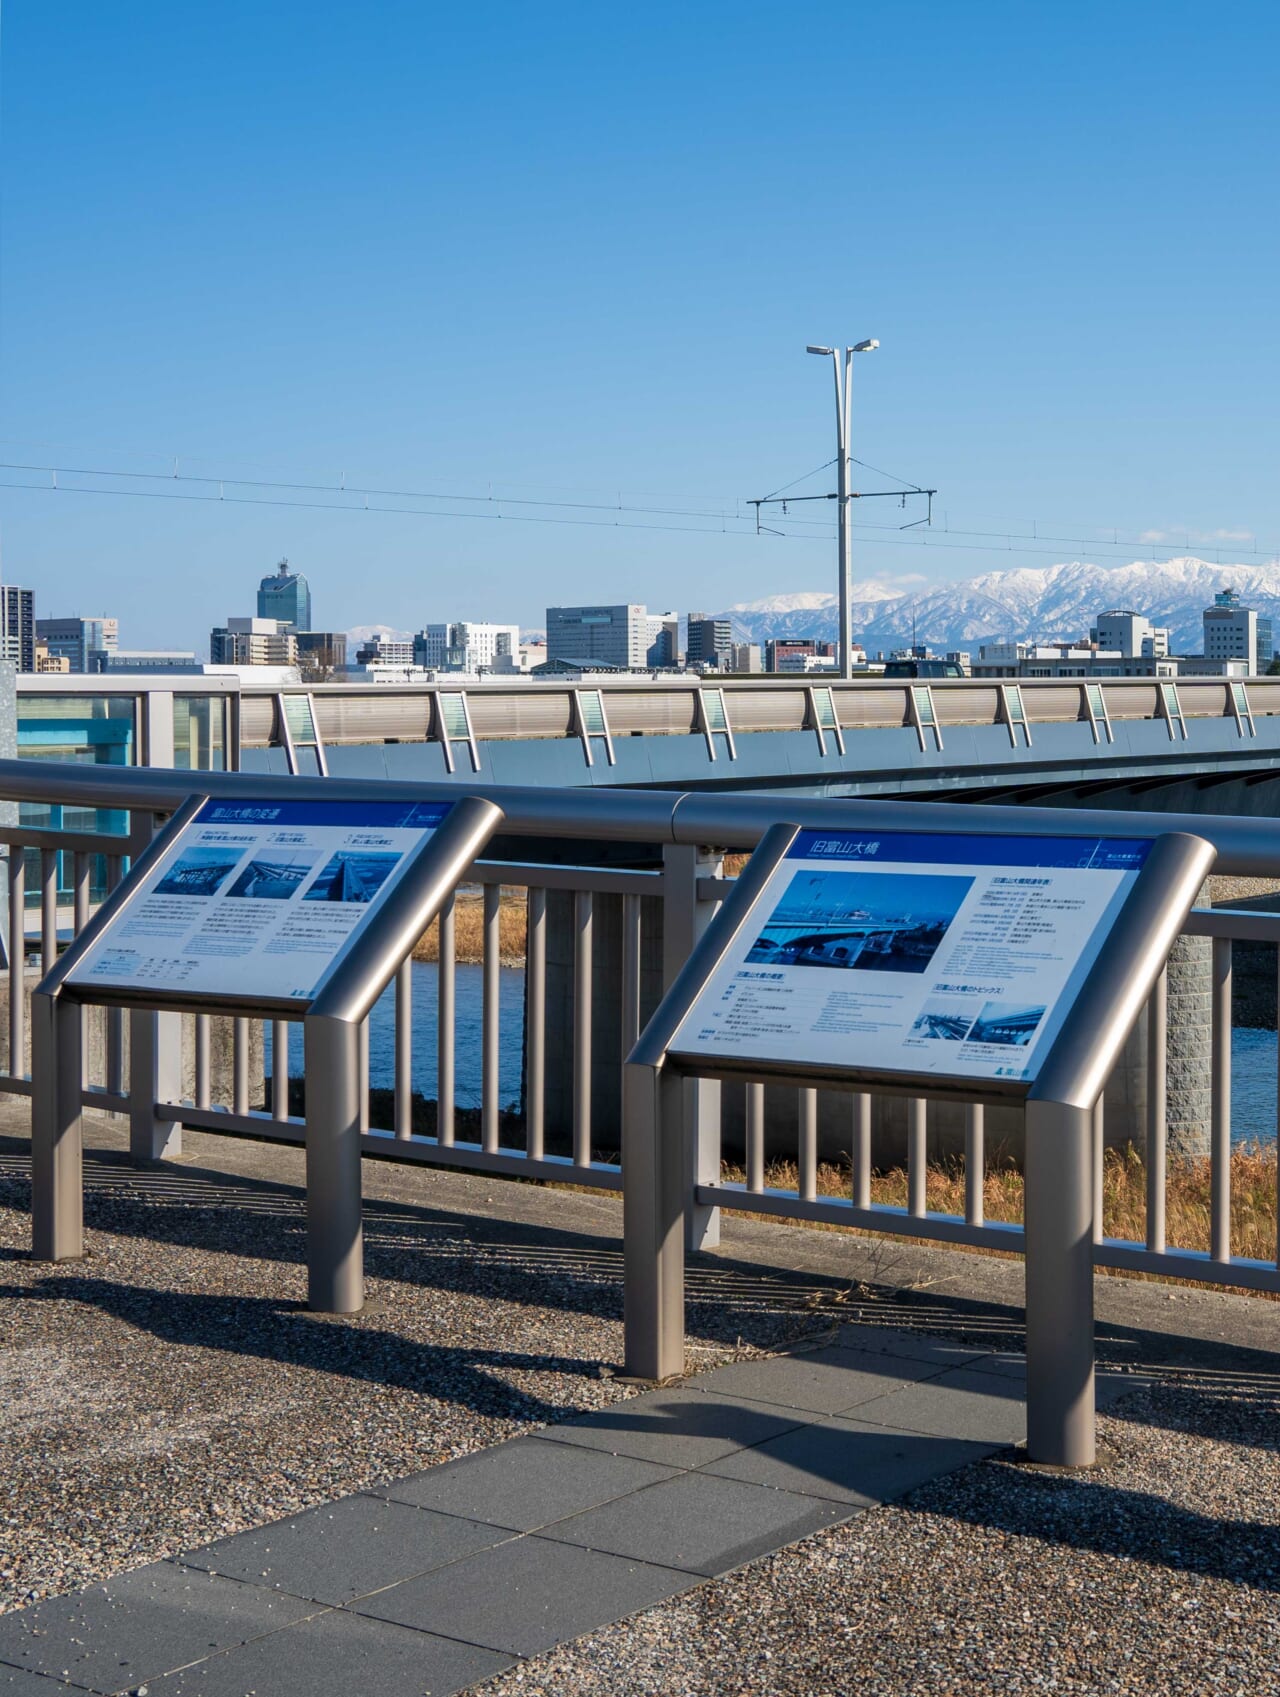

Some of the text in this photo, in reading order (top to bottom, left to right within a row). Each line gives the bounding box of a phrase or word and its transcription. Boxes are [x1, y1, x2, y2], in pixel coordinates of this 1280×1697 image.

[810, 840, 881, 855] 旧富山大橋
